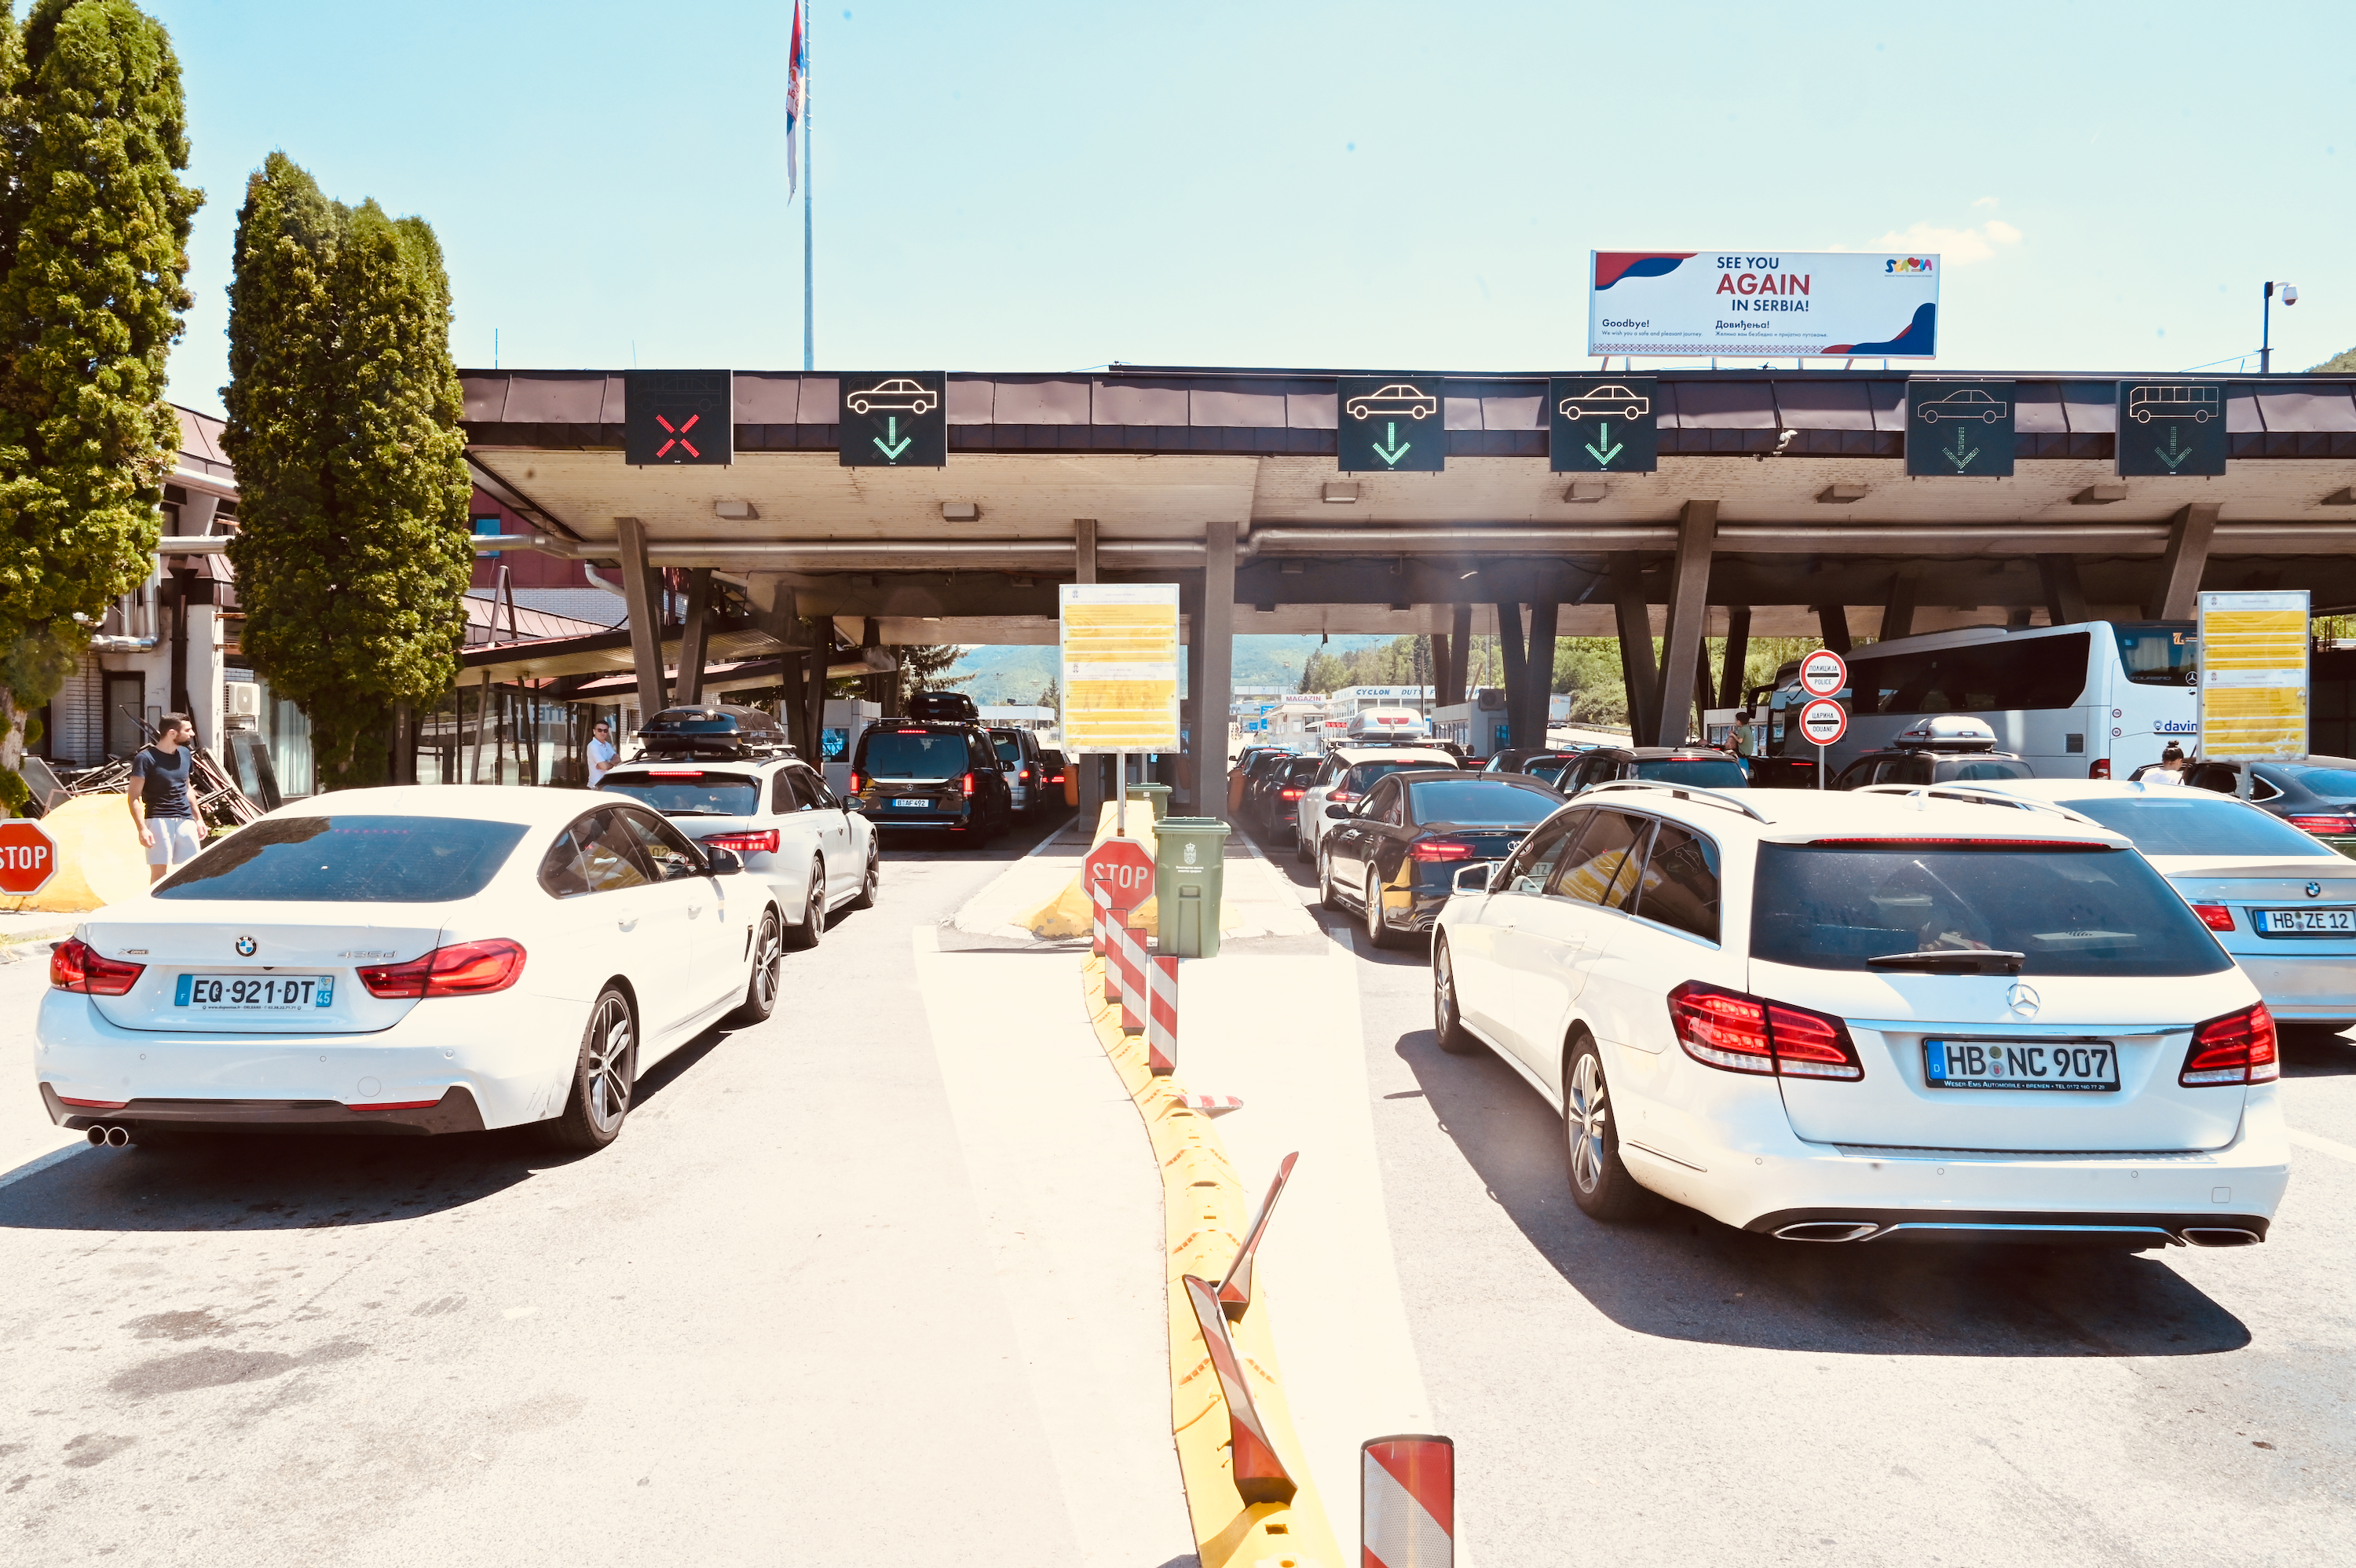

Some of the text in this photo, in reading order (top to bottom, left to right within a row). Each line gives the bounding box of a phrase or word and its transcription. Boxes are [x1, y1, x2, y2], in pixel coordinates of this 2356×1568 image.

[1717, 257, 1779, 269] SEE YOU
[1716, 273, 1810, 295] AGAIN
[1732, 299, 1809, 312] IN SERBIA!
[1602, 319, 1649, 329] Goodbye!
[1715, 320, 1770, 331] Довиђења!
[1092, 862, 1149, 890] STOP
[2273, 912, 2349, 929] HB ZE 12
[192, 980, 316, 1003] EQ-921-DT
[317, 992, 331, 1004] 45
[1933, 1064, 1941, 1073] D
[1946, 1046, 2108, 1078] HB NC 907
